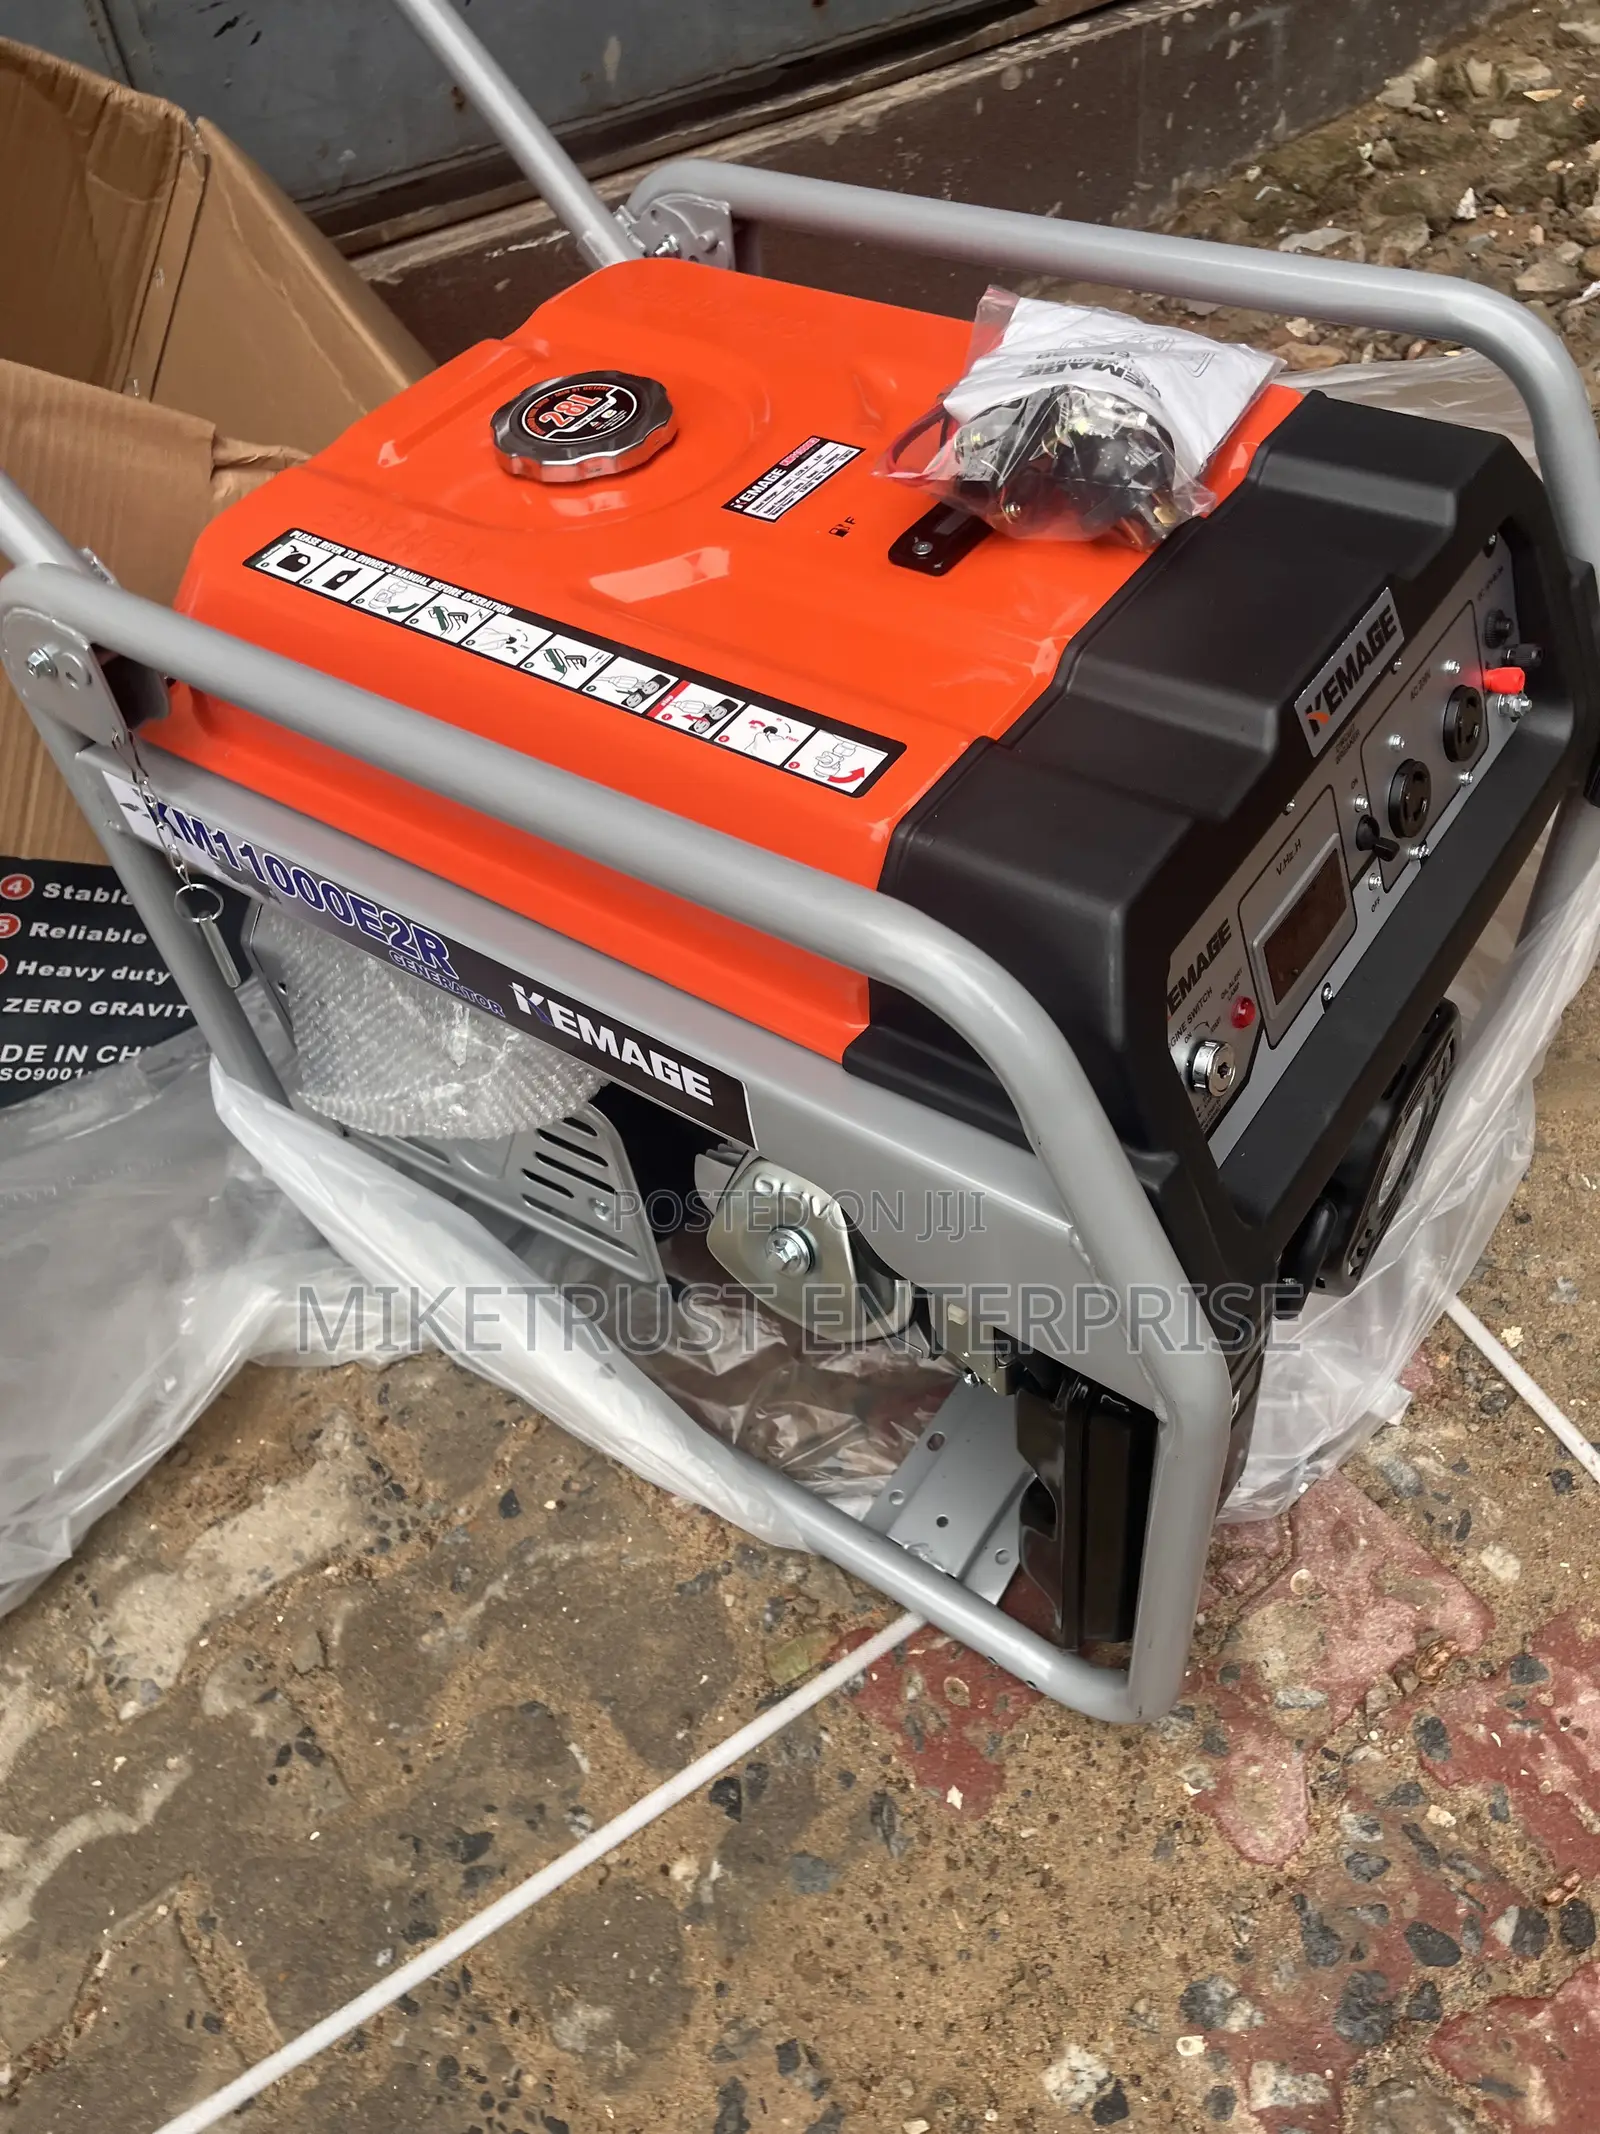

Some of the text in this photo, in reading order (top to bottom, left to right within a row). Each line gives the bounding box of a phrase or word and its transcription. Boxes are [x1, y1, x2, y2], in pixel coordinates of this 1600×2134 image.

[539, 394, 602, 427] 28L
[730, 467, 787, 509] KEMAGE
[844, 516, 856, 525] F
[289, 530, 514, 616] PLEASE REFER TO OWNER'S MANUAL BEFORE OPERATION
[1305, 604, 1398, 738] KEMAGE
[145, 794, 460, 980] KM11000E2R
[29, 921, 147, 945] Reliable
[16, 960, 171, 985] Heavy duty
[388, 949, 506, 1018] GENERATOR
[1166, 918, 1232, 1016] EMAGE
[2, 998, 192, 1018] ZERO GRAVIT
[1187, 986, 1213, 1024] SWITCH
[0, 1044, 152, 1063] DE IN CH
[508, 982, 714, 1106] KEMAGE
